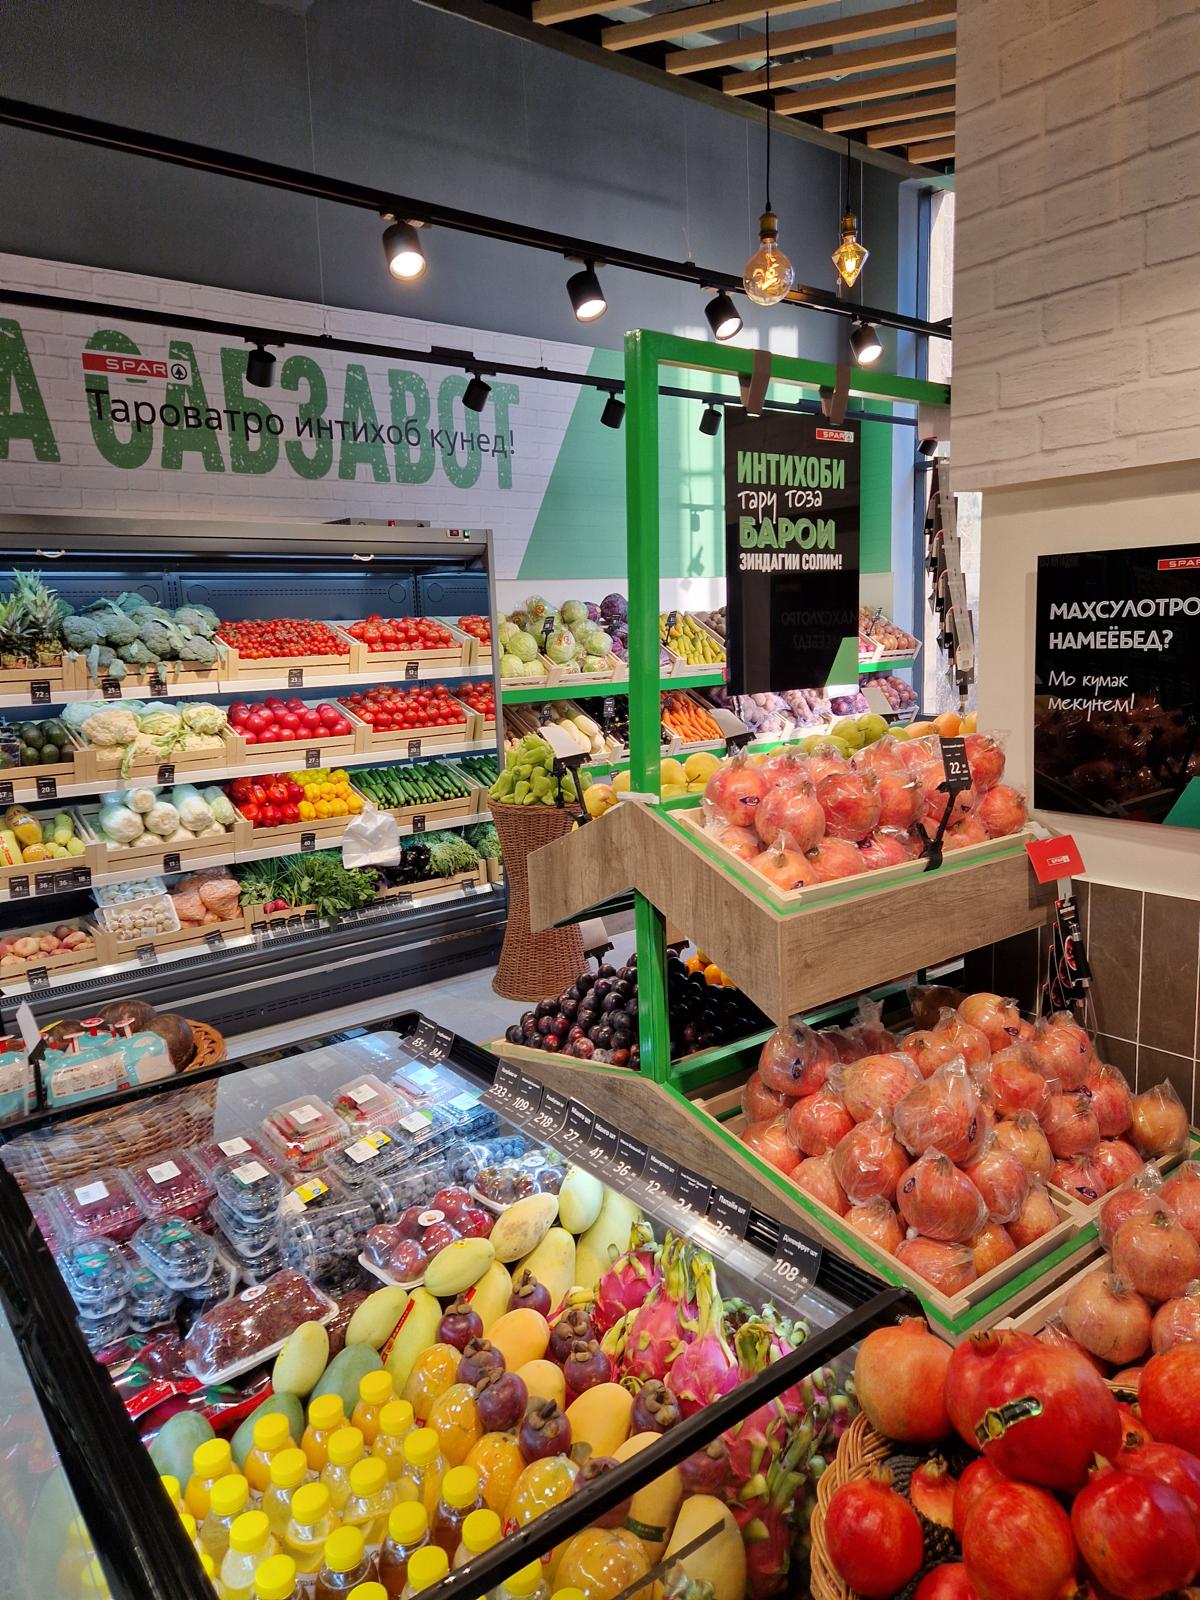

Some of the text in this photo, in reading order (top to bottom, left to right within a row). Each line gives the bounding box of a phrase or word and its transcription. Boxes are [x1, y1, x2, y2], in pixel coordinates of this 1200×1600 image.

[105, 358, 167, 375] SPAR
[84, 329, 520, 490] САБЗАВОТ
[85, 388, 515, 457] Тароватро интихоб кунед!
[822, 431, 845, 440] SPAR
[737, 451, 846, 490] ИНТИХОБИ
[739, 515, 836, 550] БАРОИ
[739, 553, 843, 572] ЗИНДАГИИ СОЛИМ!
[1049, 625, 1174, 651] НАМЕЁБЕД?
[1048, 670, 1129, 696] Мо кумак
[1047, 693, 1135, 722] мекунем!
[949, 761, 962, 775] 22
[489, 1083, 507, 1098] 233
[512, 1097, 530, 1112] 109
[534, 1112, 553, 1128] 218
[563, 1128, 580, 1143] 27
[589, 1147, 603, 1160] 41
[613, 1161, 632, 1176] 36
[644, 1180, 661, 1196] 12
[772, 1258, 800, 1283] 108
